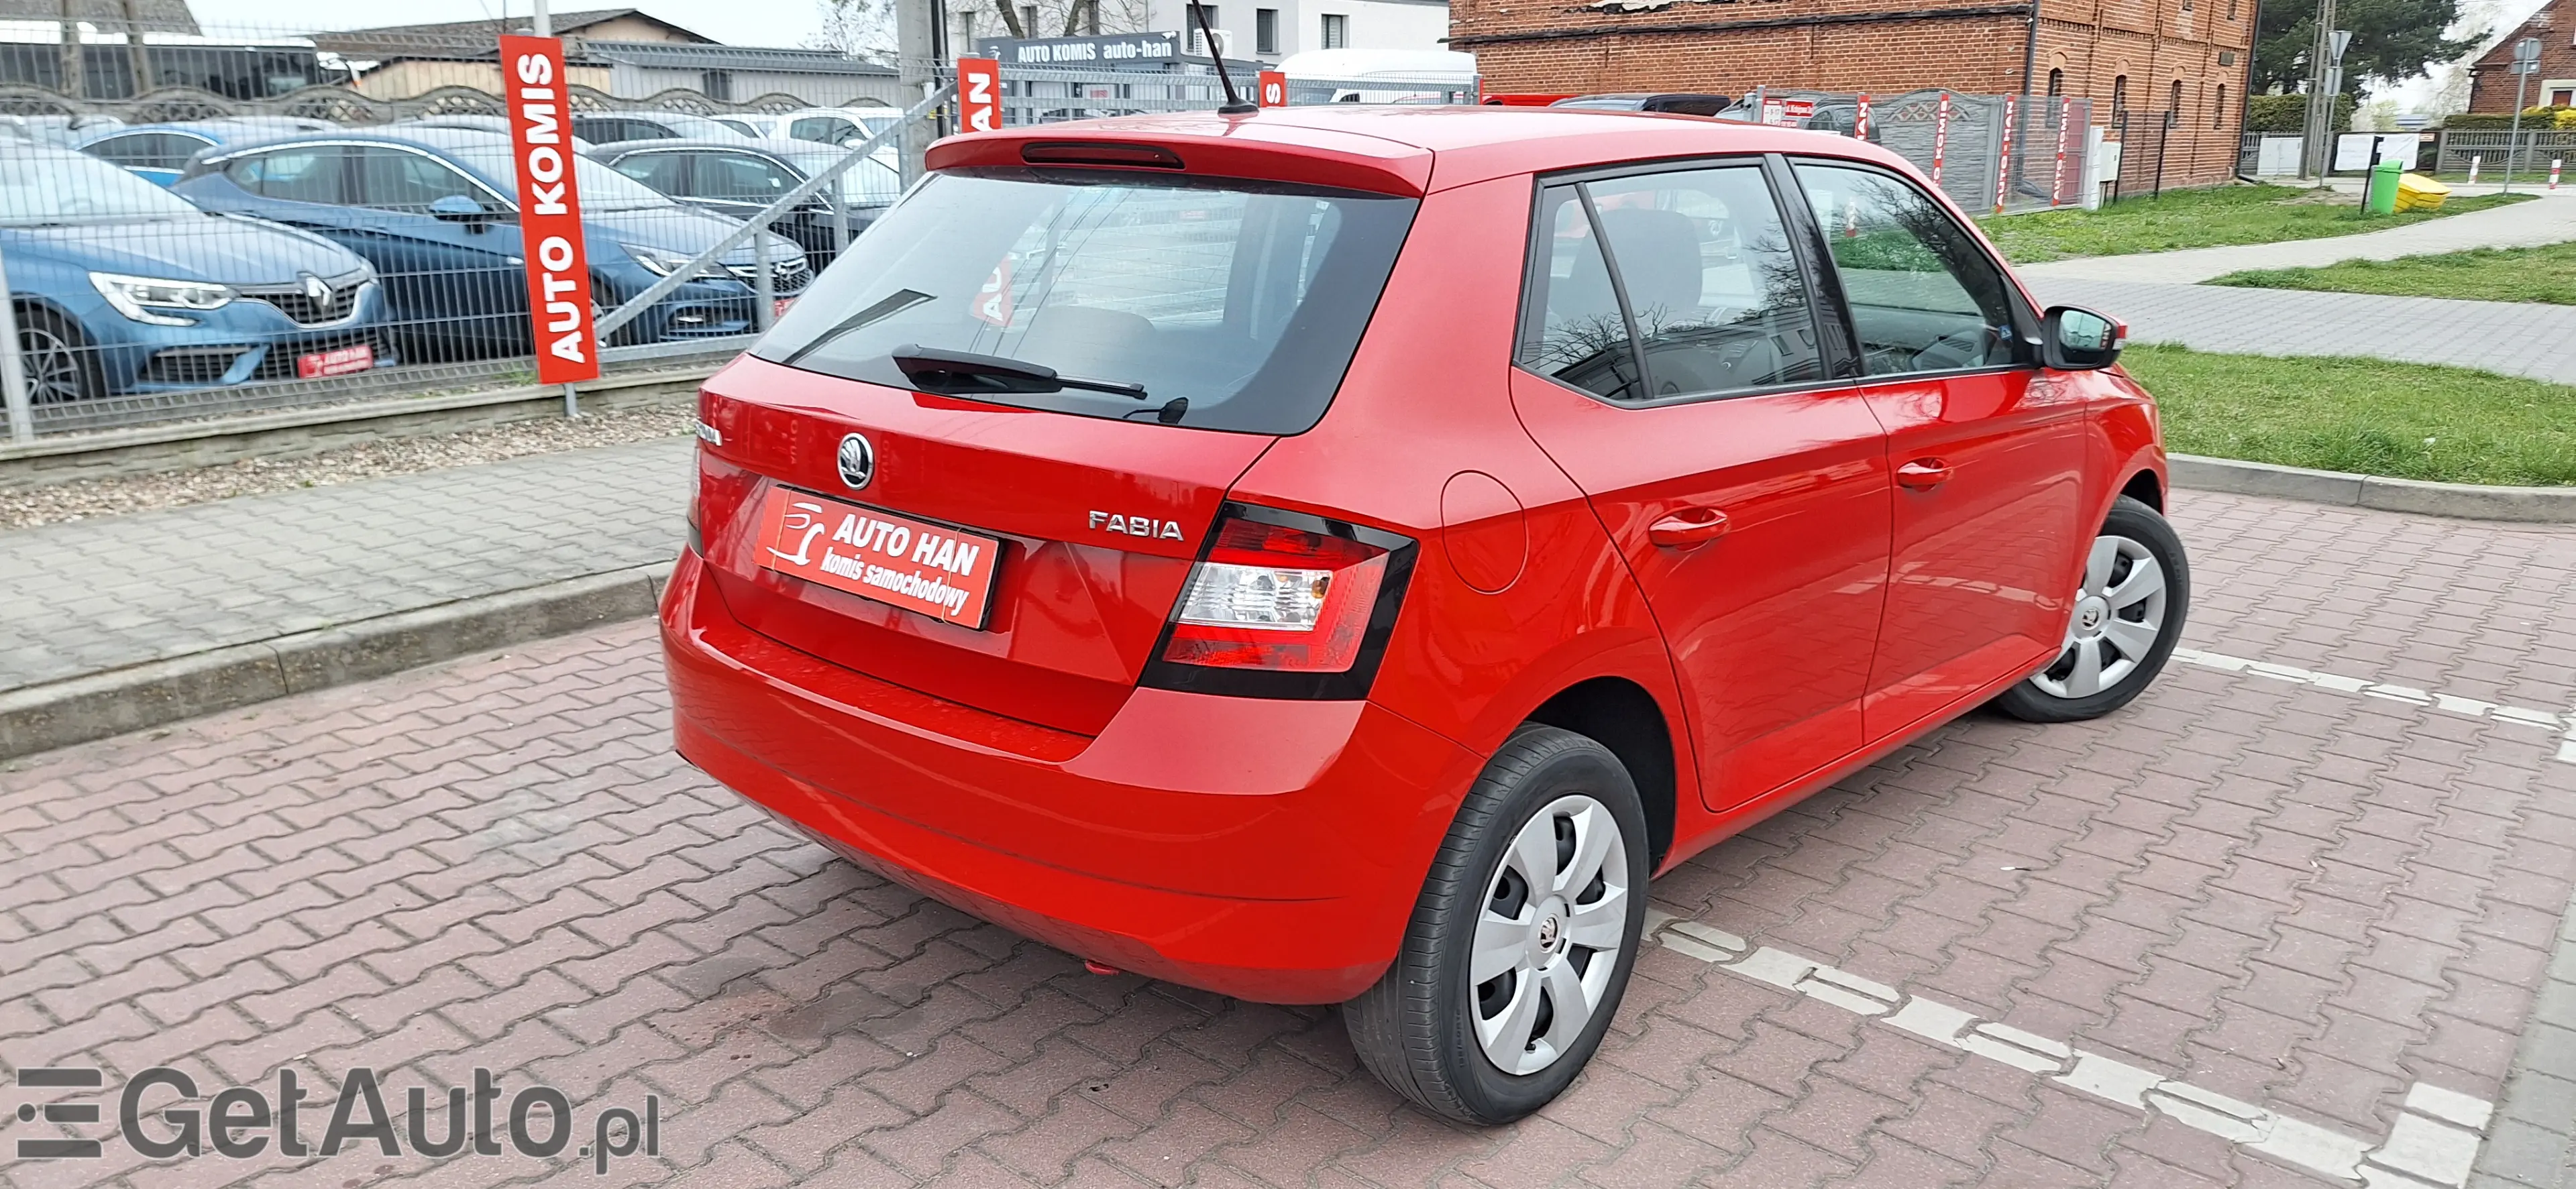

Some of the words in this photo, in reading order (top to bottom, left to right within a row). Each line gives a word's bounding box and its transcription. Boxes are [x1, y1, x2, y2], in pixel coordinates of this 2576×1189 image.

[1018, 46, 1051, 63] AUTO
[1053, 43, 1096, 61] KOMIS
[1103, 40, 1172, 60] auto-han
[967, 72, 993, 131] AN
[1857, 102, 1868, 140] AN
[1935, 100, 1947, 160] KOMIS
[517, 54, 568, 215] KOMIS
[1997, 156, 2008, 206] AUTO
[2004, 101, 2013, 141] HAN
[2053, 160, 2063, 200] AUTO
[2058, 103, 2069, 152] KOMIS
[539, 236, 586, 363] AUTO
[832, 514, 910, 557] AUTO
[912, 533, 979, 576] HAN
[1089, 510, 1184, 541] FABIA
[820, 547, 863, 581] komis
[863, 564, 971, 616] samochodowy
